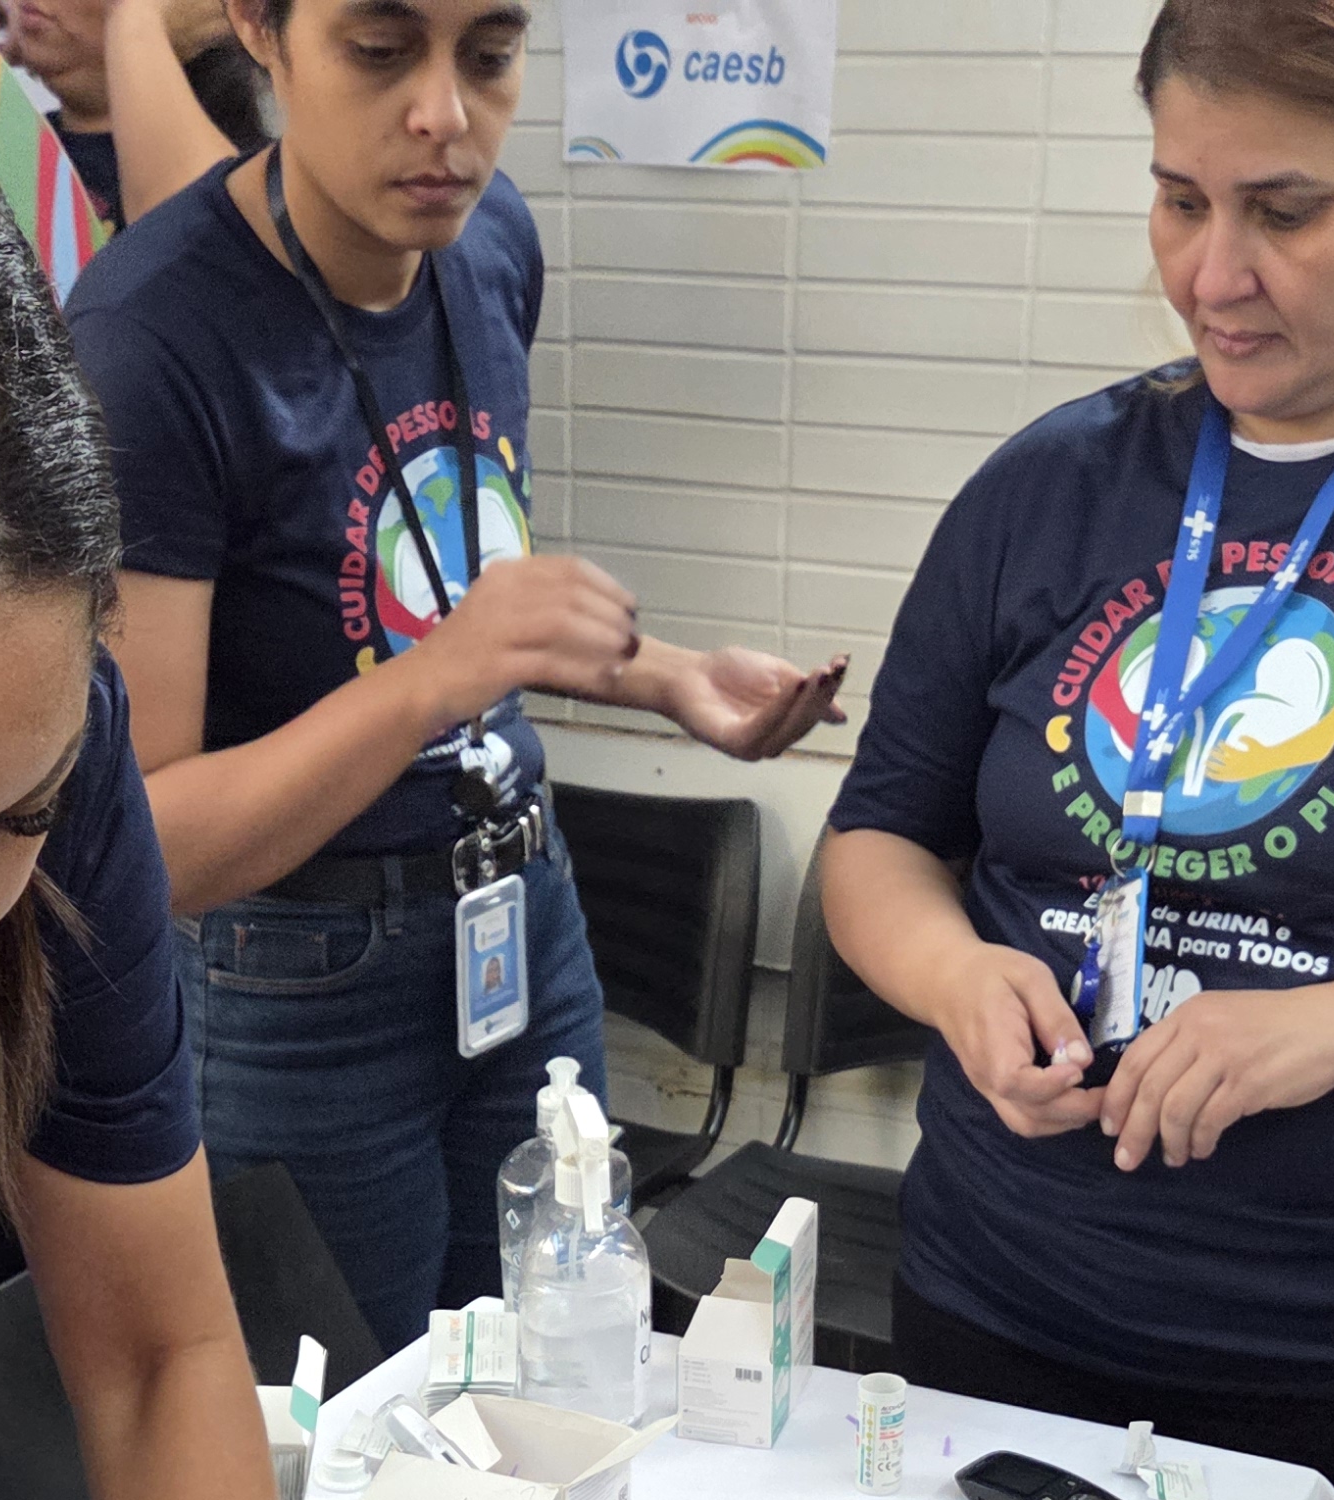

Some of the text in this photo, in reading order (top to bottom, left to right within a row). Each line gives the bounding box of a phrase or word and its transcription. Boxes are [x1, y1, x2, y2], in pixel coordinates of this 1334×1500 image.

[684, 46, 785, 85] caesb
[338, 498, 371, 641] CUIDAR
[385, 400, 492, 453] PESSOS
[1053, 577, 1154, 706] CUIDAR
[1053, 762, 1081, 793] E
[1064, 791, 1258, 881] PROTEGER
[1263, 825, 1299, 860] O
[1187, 909, 1269, 938] URINA
[1178, 936, 1230, 957] para
[1237, 939, 1329, 977] TODOS
